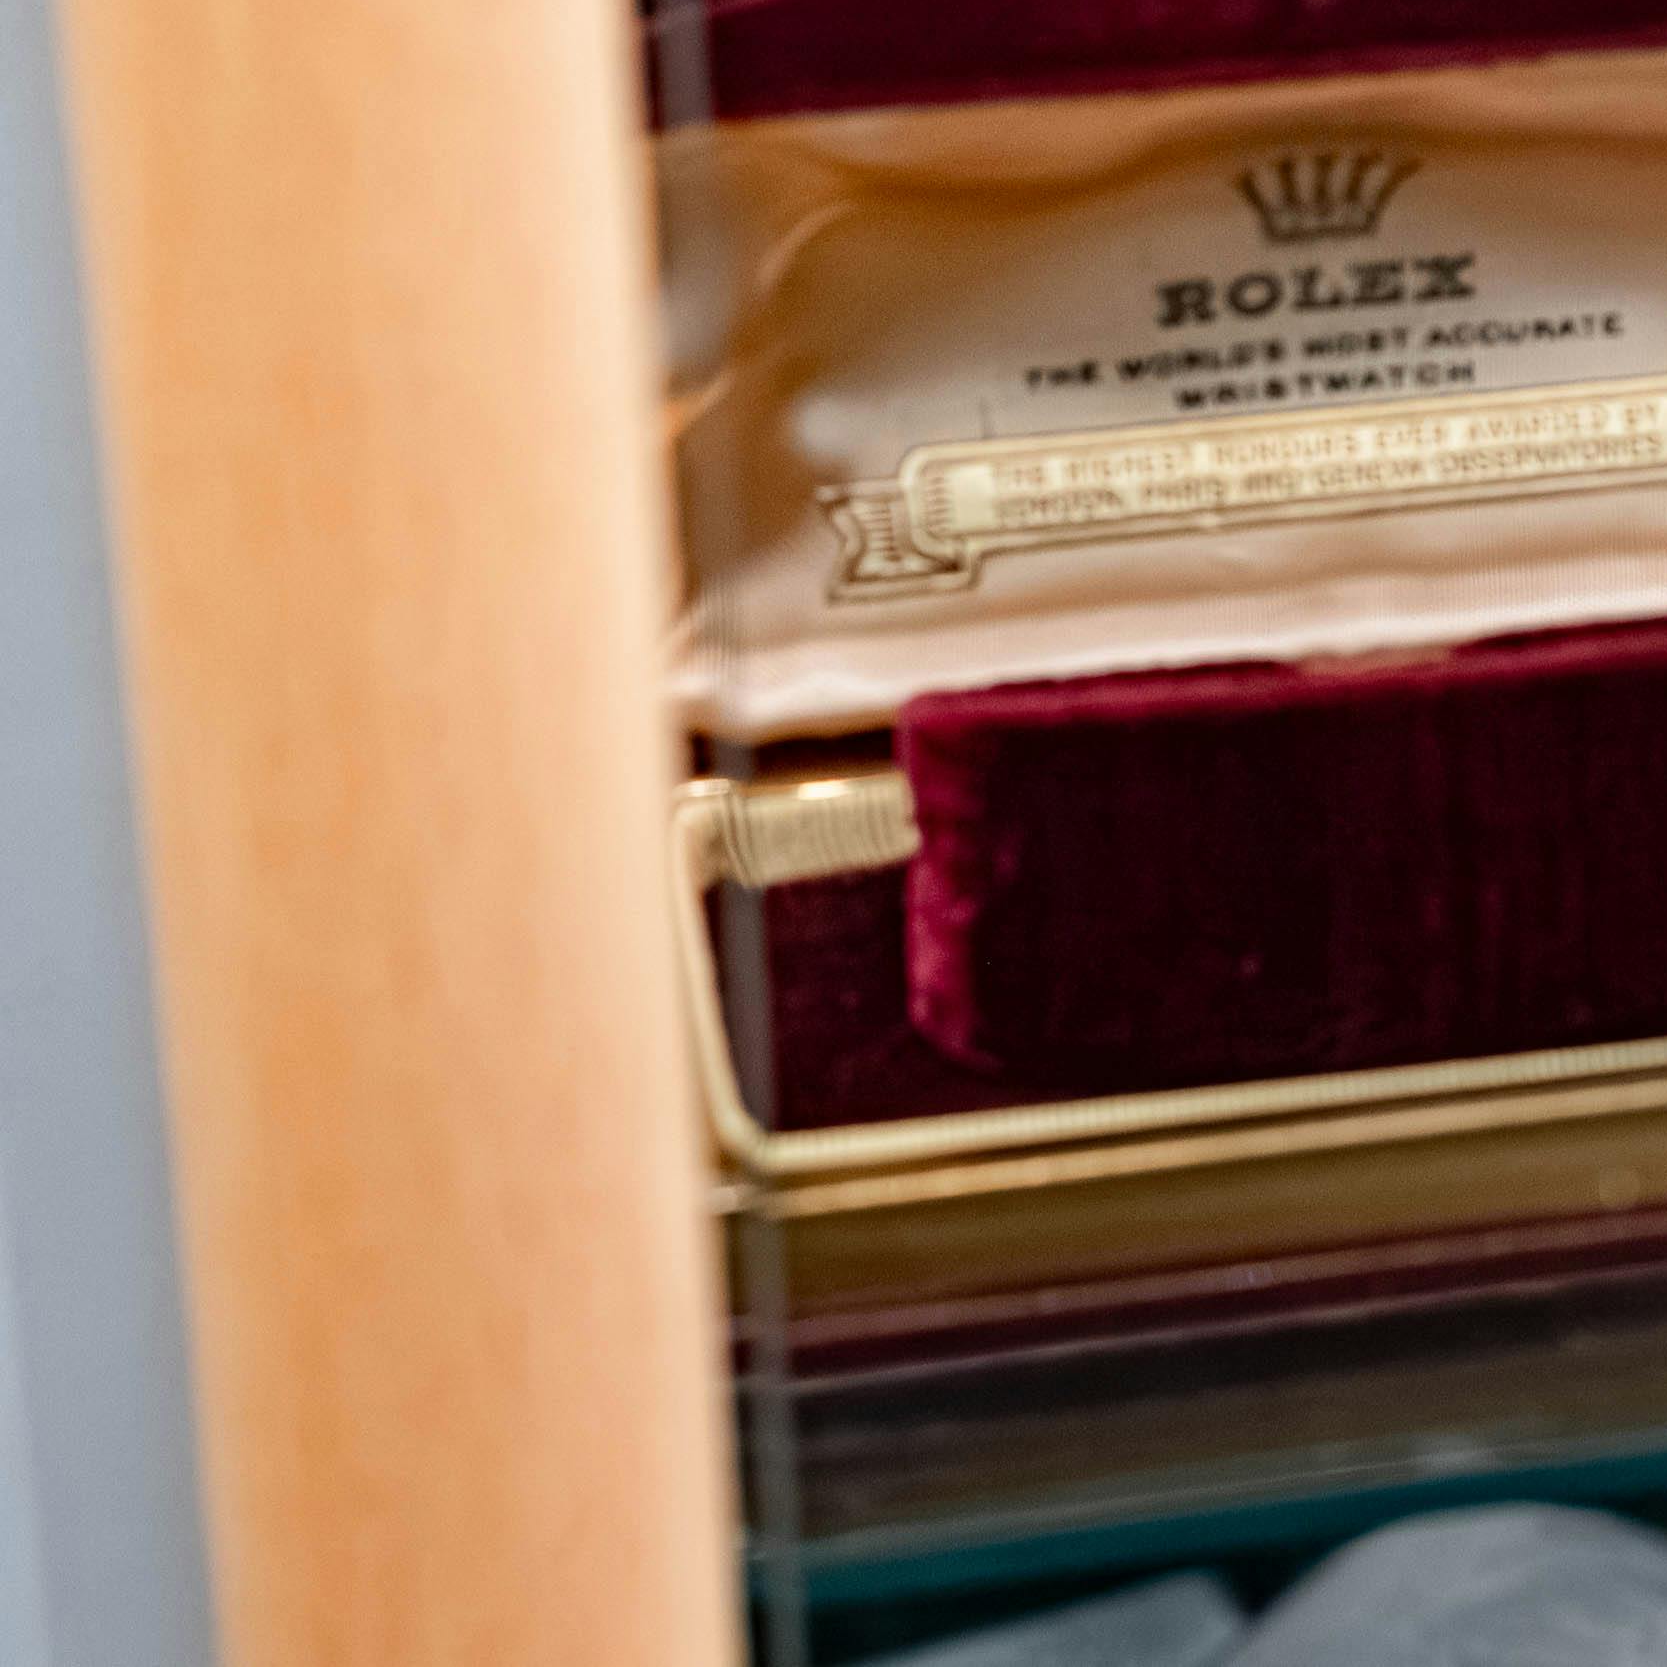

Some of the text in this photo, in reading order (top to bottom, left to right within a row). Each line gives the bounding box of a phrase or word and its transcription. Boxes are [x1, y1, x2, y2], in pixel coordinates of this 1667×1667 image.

[1155, 252, 1477, 329] ROLEX
[1024, 360, 1099, 389] THE
[1304, 327, 1409, 358] MOST
[1426, 312, 1625, 348] ACCURATE
[1174, 361, 1477, 411] WRISTWATCH
